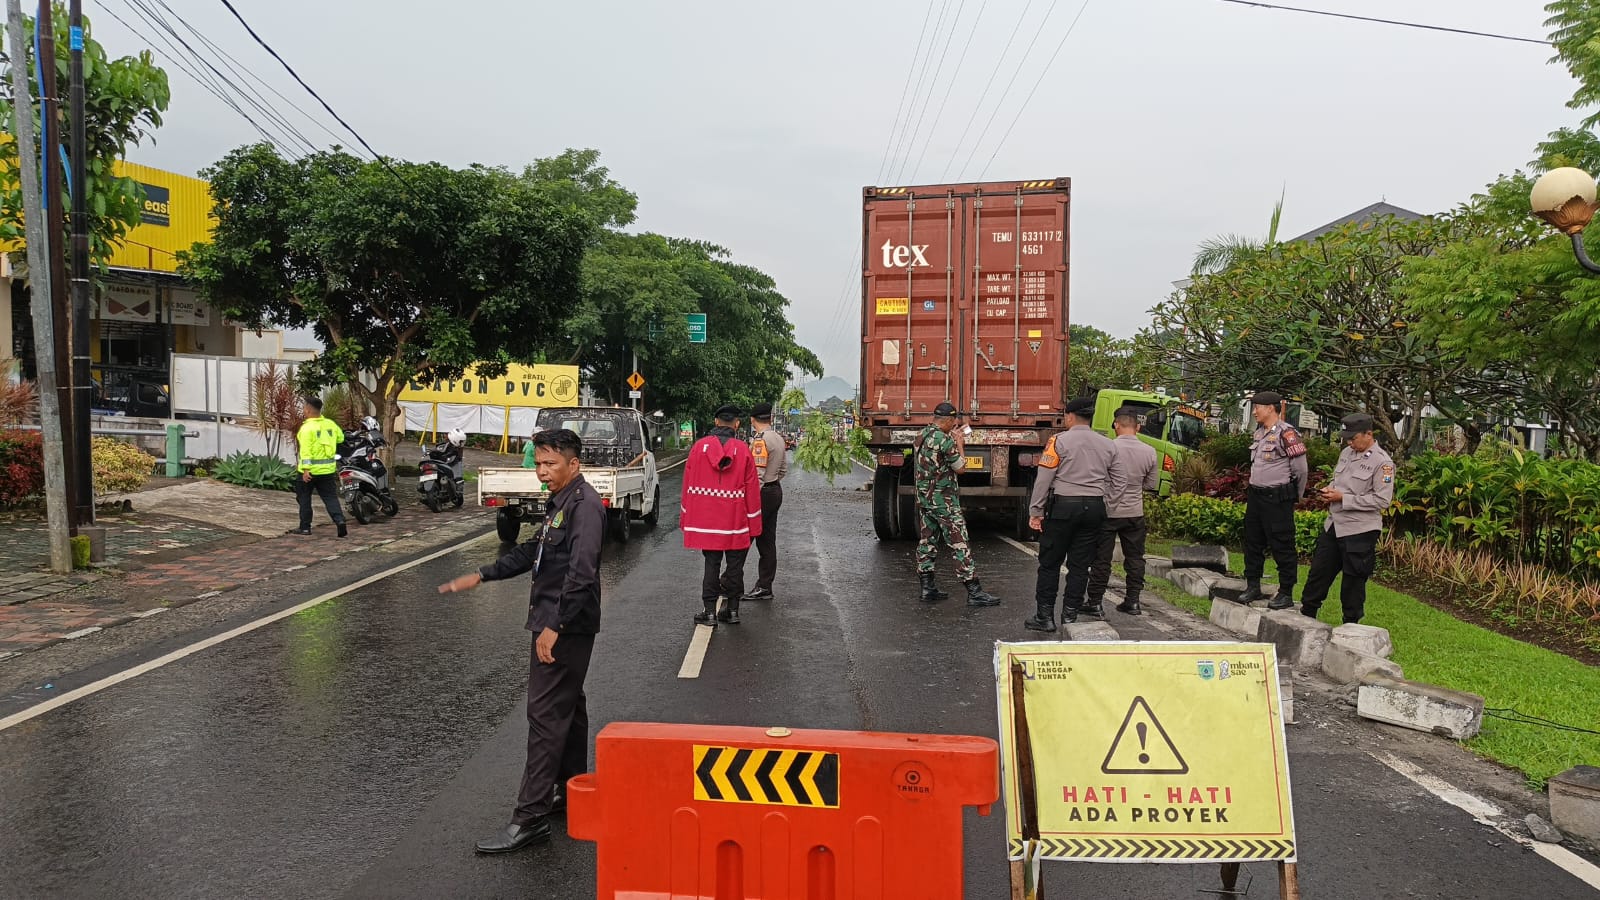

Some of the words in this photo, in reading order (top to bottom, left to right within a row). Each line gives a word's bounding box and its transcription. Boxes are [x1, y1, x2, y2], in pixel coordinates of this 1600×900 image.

[992, 231, 1013, 242] TEMU
[1022, 231, 1054, 242] 633117
[881, 238, 930, 268] tex
[1022, 244, 1043, 255] 45G1
[987, 285, 1000, 293] TARE
[923, 300, 935, 308] GL
[987, 297, 1010, 305] PAYLOAD
[522, 373, 546, 382] #BATU
[505, 381, 546, 398] PVC
[1230, 661, 1260, 669] mbatu
[1063, 786, 1127, 803] HATI
[1167, 787, 1232, 804] HATI
[1069, 807, 1118, 822] ADA
[1131, 808, 1229, 823] PROYEK
